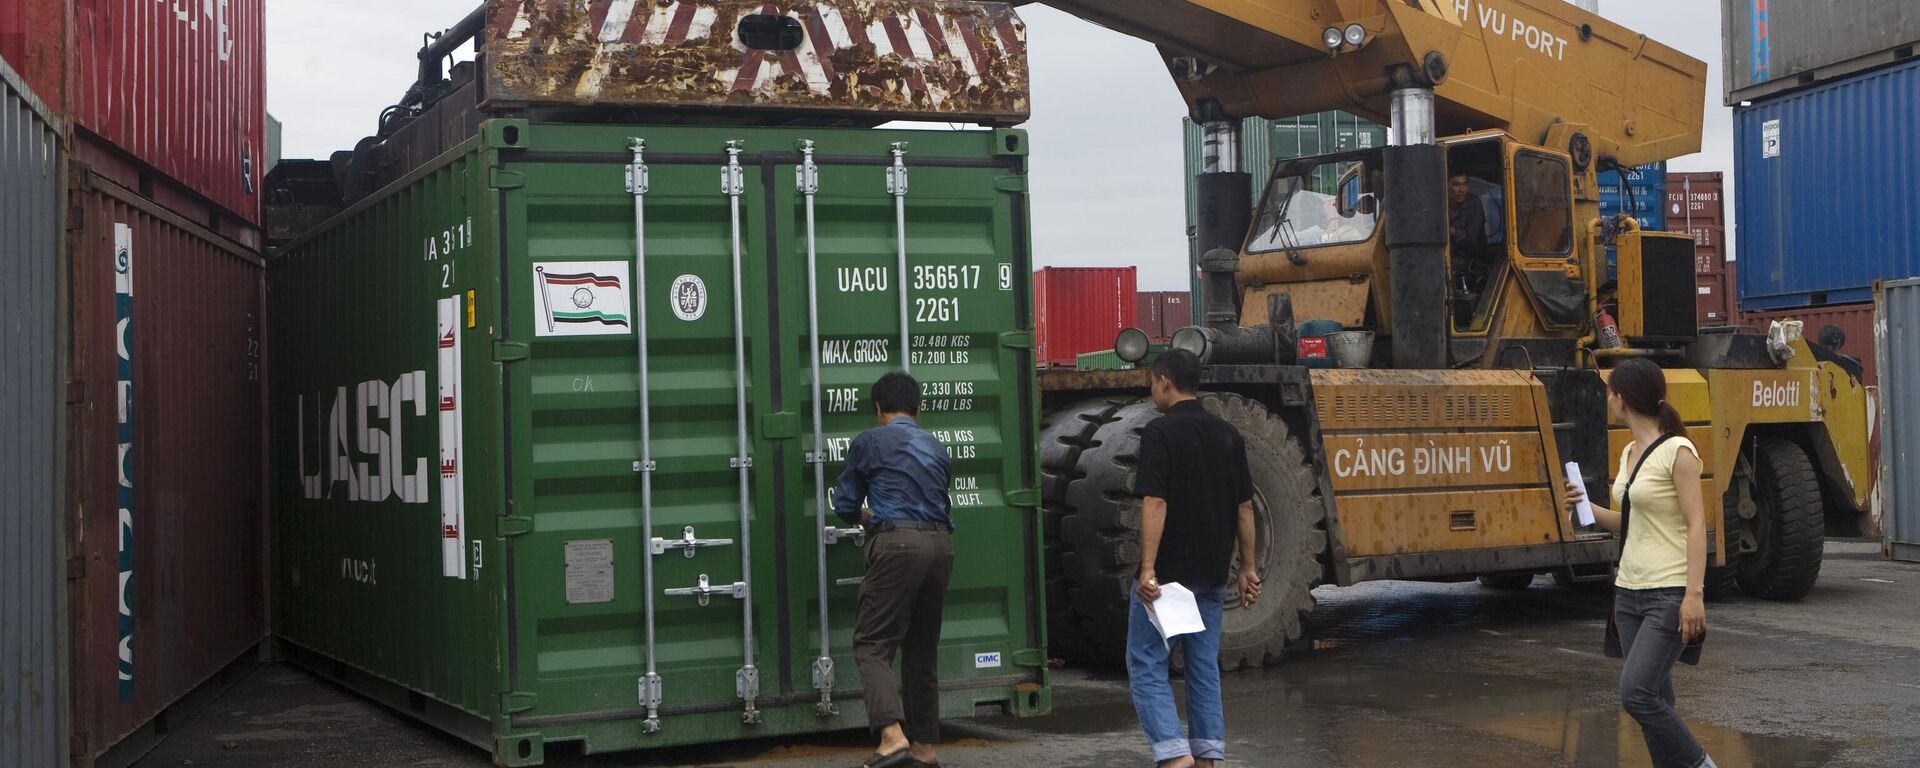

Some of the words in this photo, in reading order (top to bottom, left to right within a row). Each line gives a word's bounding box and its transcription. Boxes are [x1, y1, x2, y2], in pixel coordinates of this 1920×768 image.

[1478, 3, 1506, 35] VU
[1511, 18, 1568, 61] PORT
[837, 266, 888, 292] UACU
[913, 265, 980, 290] 356517
[1000, 264, 1011, 289] 9
[916, 297, 959, 322] 22G1
[912, 335, 947, 348] 30.480
[951, 336, 970, 347] KGS
[911, 351, 946, 364] 67.200
[950, 352, 969, 364] LBS
[922, 383, 950, 395] 2.330
[955, 382, 974, 395] KGS
[1752, 380, 1800, 407] Belotti
[827, 388, 858, 412] TARE
[920, 399, 949, 411] 5.140
[953, 399, 972, 411] LBS
[299, 370, 429, 503] UASC
[955, 430, 974, 442] KGS
[827, 437, 850, 461] NET
[957, 446, 976, 458] LBS
[1334, 438, 1405, 478] CẢNG
[1413, 440, 1471, 475] ĐÌNH
[1480, 439, 1511, 473] VŨ
[954, 476, 979, 490] CU.M.
[977, 655, 999, 663] CIMC
